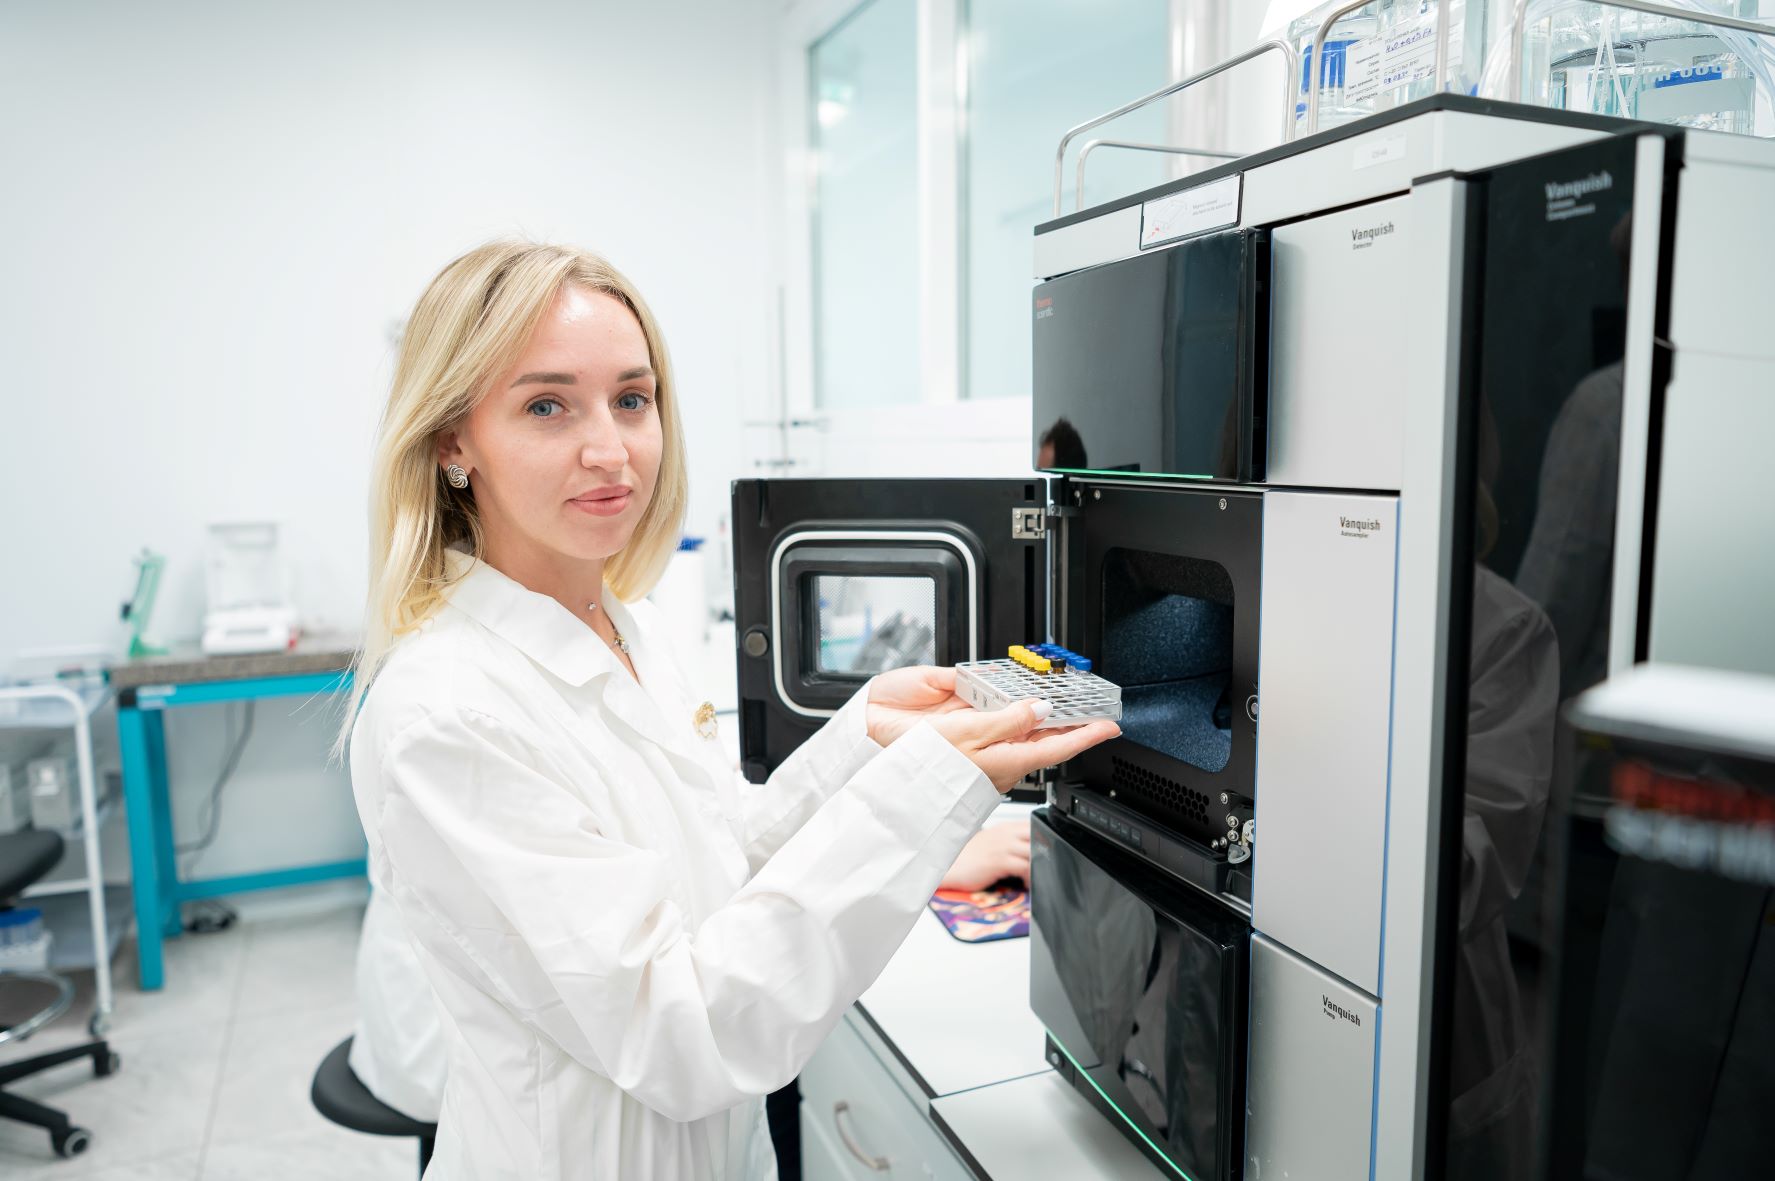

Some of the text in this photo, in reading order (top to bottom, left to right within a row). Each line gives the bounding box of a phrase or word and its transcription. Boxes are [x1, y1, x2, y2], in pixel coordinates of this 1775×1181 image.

[1545, 169, 1613, 199] Vanquish
[1352, 221, 1394, 241] Vanquish
[1340, 516, 1380, 532] Vanquish
[1323, 994, 1361, 1027] Vanquish
